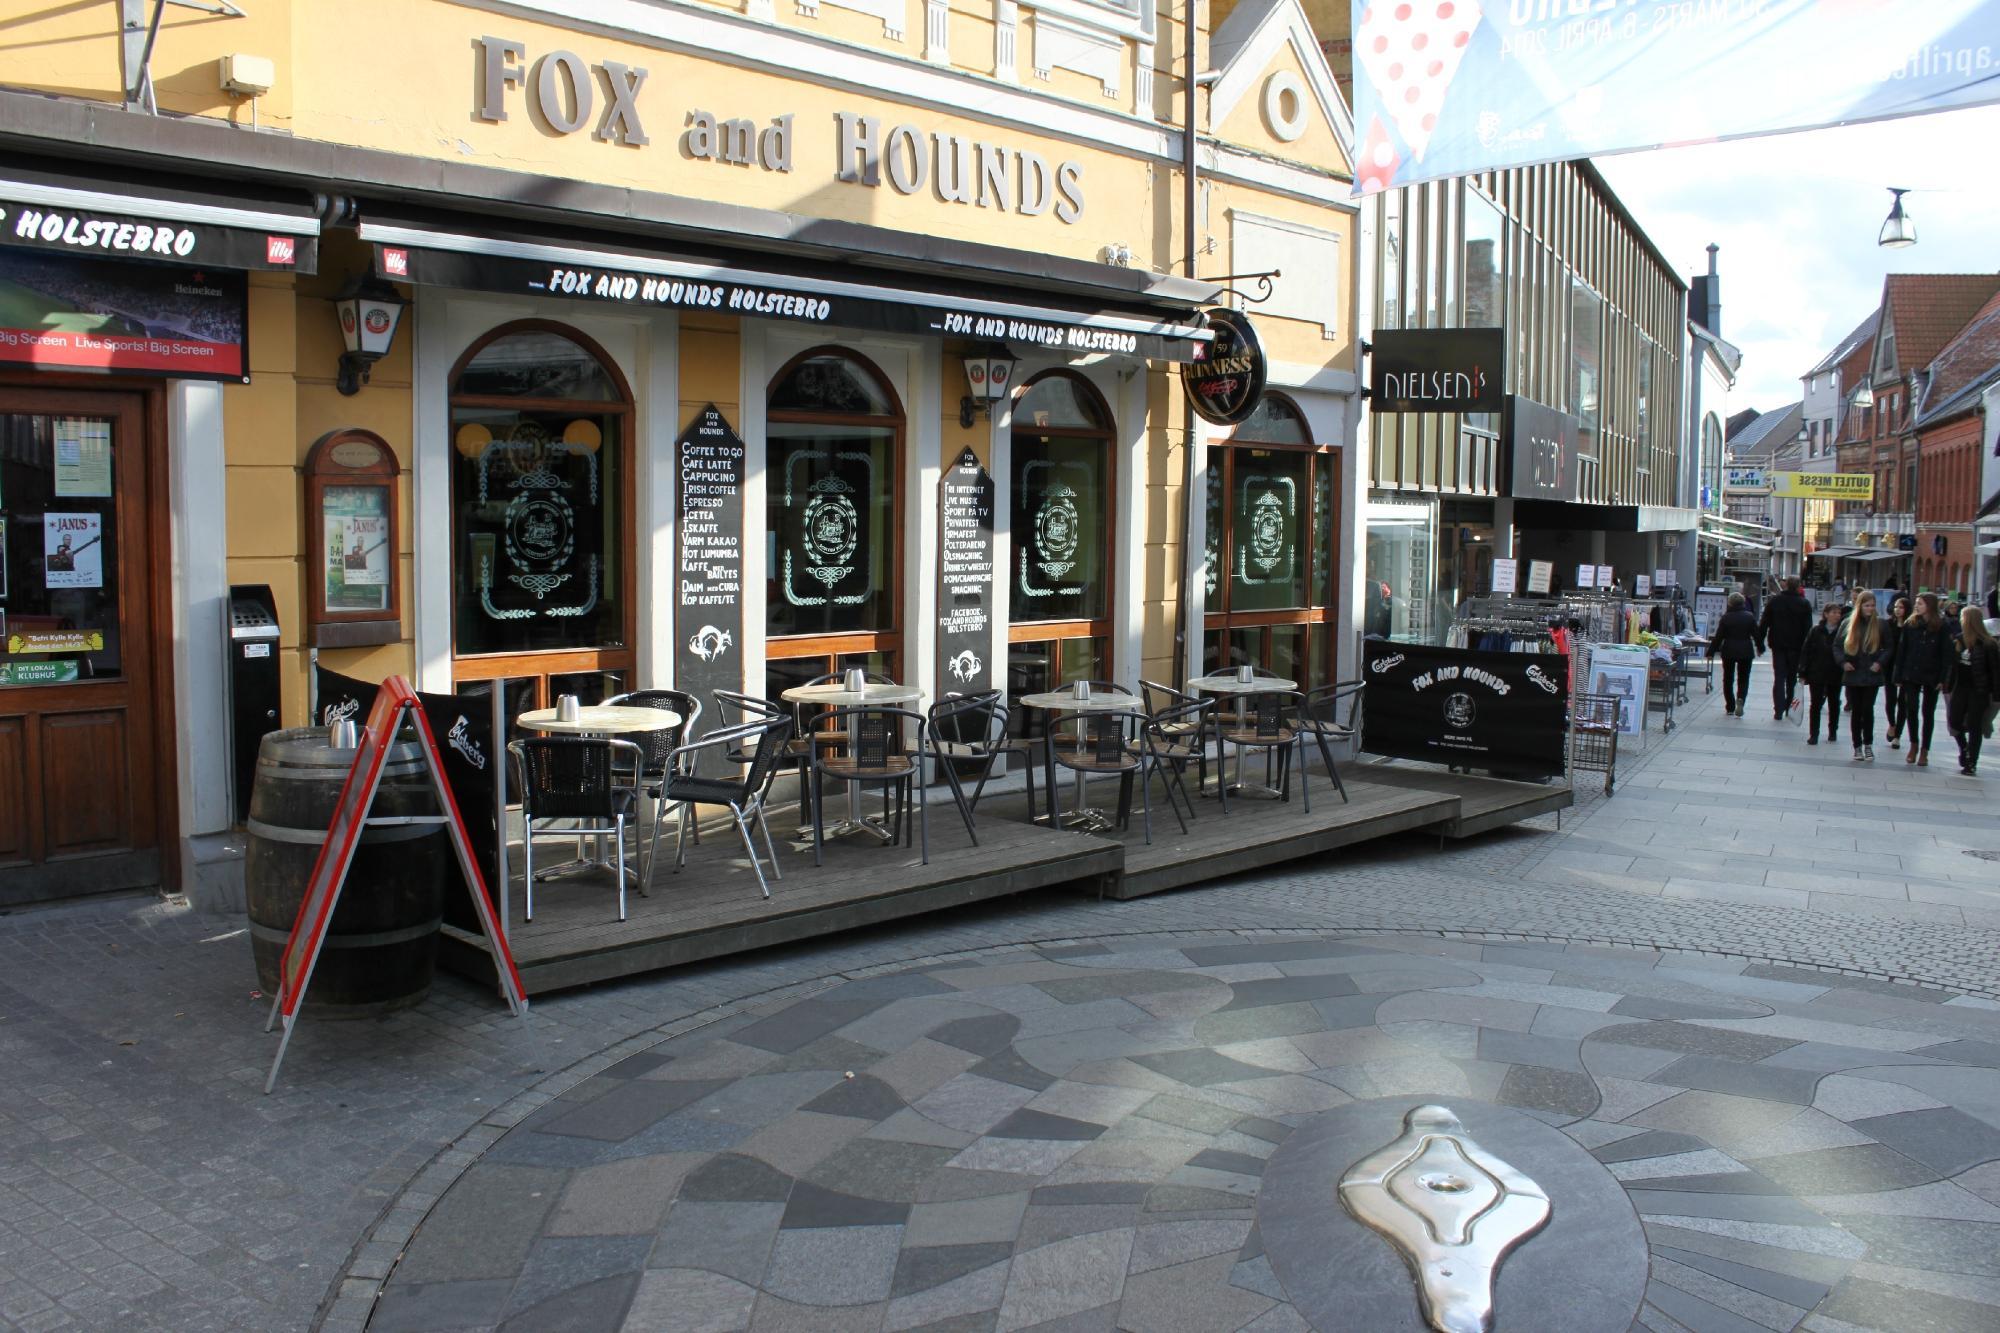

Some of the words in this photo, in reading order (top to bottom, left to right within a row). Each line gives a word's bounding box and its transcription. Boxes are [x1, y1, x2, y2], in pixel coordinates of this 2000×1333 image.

[478, 35, 649, 146] FOX
[690, 110, 795, 173] and
[836, 111, 1086, 225] HOUNDS
[16, 210, 195, 256] HOLSTEBRO
[270, 240, 293, 261] illy
[386, 252, 406, 273] illy
[175, 284, 222, 297] Heineken
[549, 269, 591, 295] FOX
[595, 274, 638, 300] AND
[642, 279, 723, 307] HOUNDS
[728, 288, 830, 320] HOLSTEBRO
[944, 313, 972, 334] FOX
[975, 317, 1006, 337] AND
[1009, 321, 1063, 345] HOUNDS
[1067, 327, 1137, 353] HOLSTEBRO
[20, 332, 67, 347] Screen
[75, 336, 101, 349] Live
[102, 338, 148, 353] Sports!
[151, 342, 170, 357] Big
[172, 344, 214, 356] Screen
[1184, 357, 1252, 379] GUINNESS
[699, 427, 724, 435] HOUNDS
[682, 442, 714, 456] COFFEE
[719, 447, 729, 456] TO
[731, 448, 743, 458] GO
[682, 469, 736, 483] CAPPUCINO
[683, 481, 706, 494] IRISH
[709, 486, 737, 495] COFFEE
[956, 486, 985, 494] INTERNET
[683, 494, 724, 507] ESPRESSO
[683, 507, 715, 520] ICETEA
[944, 505, 967, 516] SPORT
[979, 508, 988, 516] TV
[56, 516, 88, 533] JANUS
[352, 518, 378, 535] JANUS
[683, 520, 718, 533] ISKAFFE
[944, 516, 980, 528] PRIVATFEST
[681, 532, 705, 546] VARM
[707, 537, 738, 546] KAKAO
[944, 527, 977, 539] FIRMAFEST
[944, 539, 987, 550] POLTERABEND
[682, 546, 698, 559] HOT
[701, 549, 739, 559] LUMUMBA
[944, 550, 983, 561] ØLSMAGNING
[682, 559, 709, 572] KAFFE
[707, 569, 738, 579] BAILYES
[682, 580, 704, 593] DAIM
[718, 583, 740, 592] CUBA
[951, 585, 982, 594] SMAGNING
[682, 593, 698, 606] KOP
[699, 595, 735, 605] KAFFE/TE
[951, 608, 983, 617] FACEBOOK:
[948, 623, 983, 633] HOLSTEBRO
[1371, 652, 1405, 673] Carlsberg
[18, 671, 56, 680] KLUBHUS
[1412, 672, 1434, 692] FOX
[1437, 666, 1460, 681] AND
[1463, 666, 1512, 696] HOUNDS
[1526, 664, 1559, 694] Carlsberg
[325, 698, 359, 727] Carlsberg
[448, 715, 485, 769] Carlsberg
